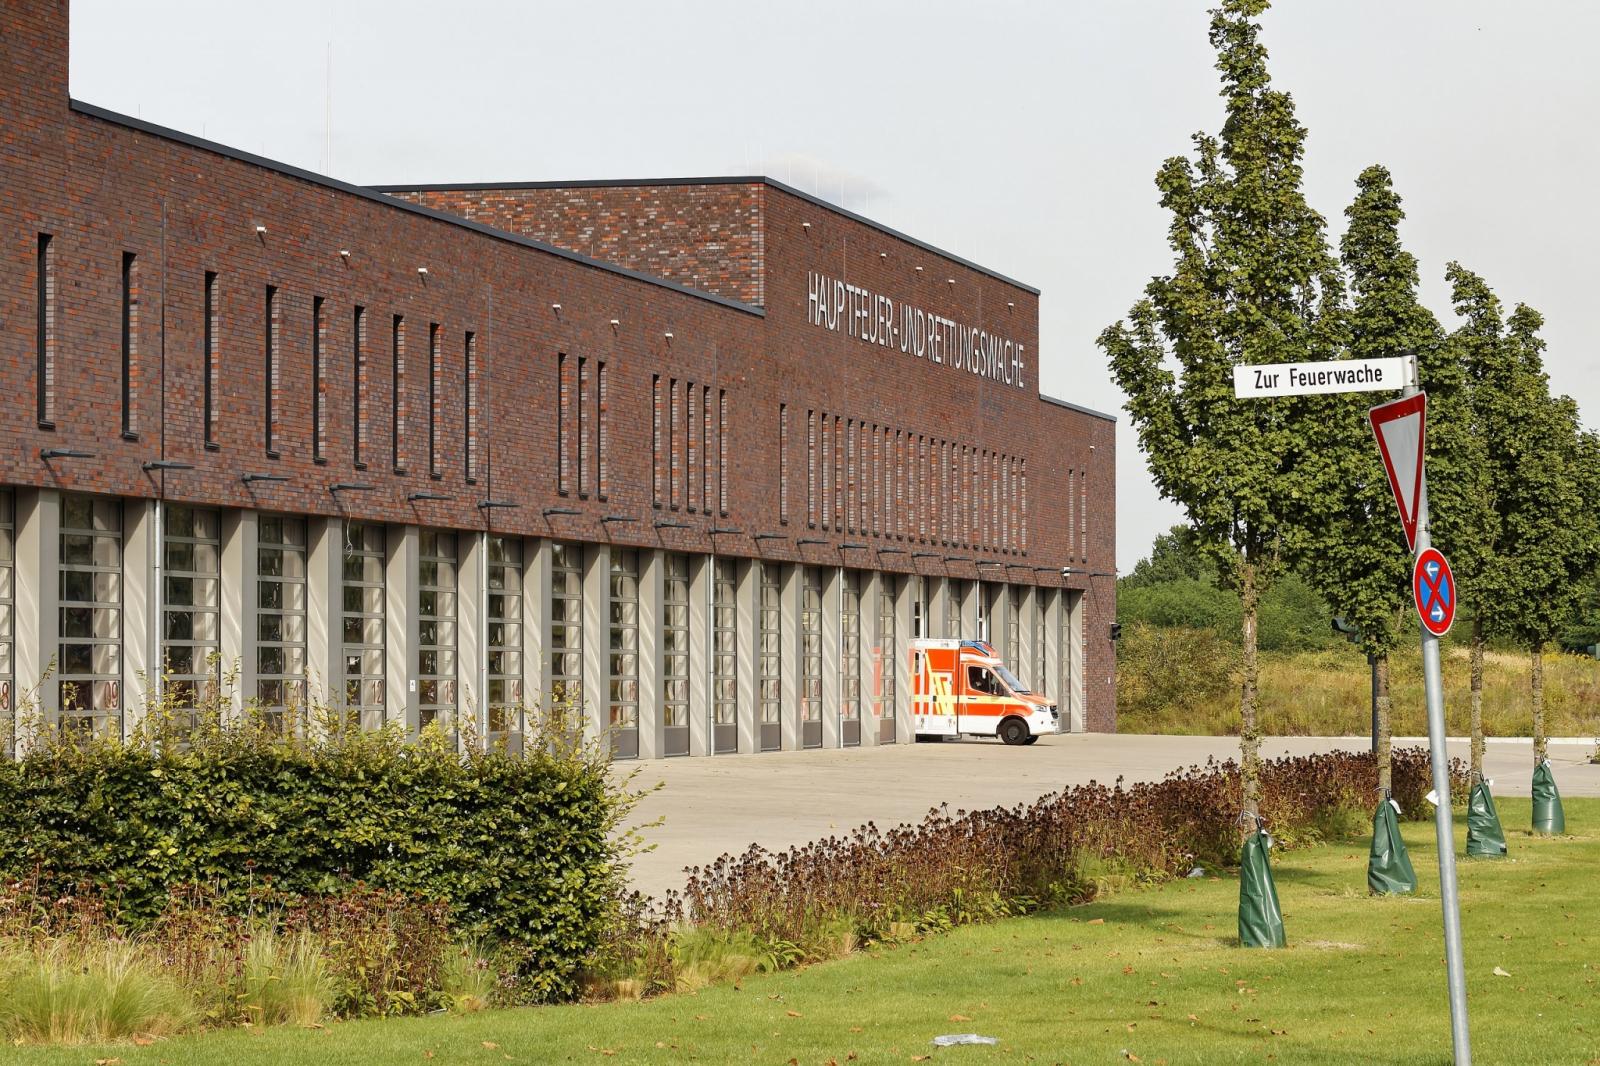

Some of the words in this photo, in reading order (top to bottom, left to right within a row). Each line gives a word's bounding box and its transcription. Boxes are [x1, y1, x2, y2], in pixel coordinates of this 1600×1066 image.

[927, 313, 1024, 389] RETTUNGSWACHE
[1254, 370, 1280, 389] Zur
[1289, 364, 1383, 387] Feuerwache
[104, 682, 119, 708] 09
[372, 681, 383, 703] 12
